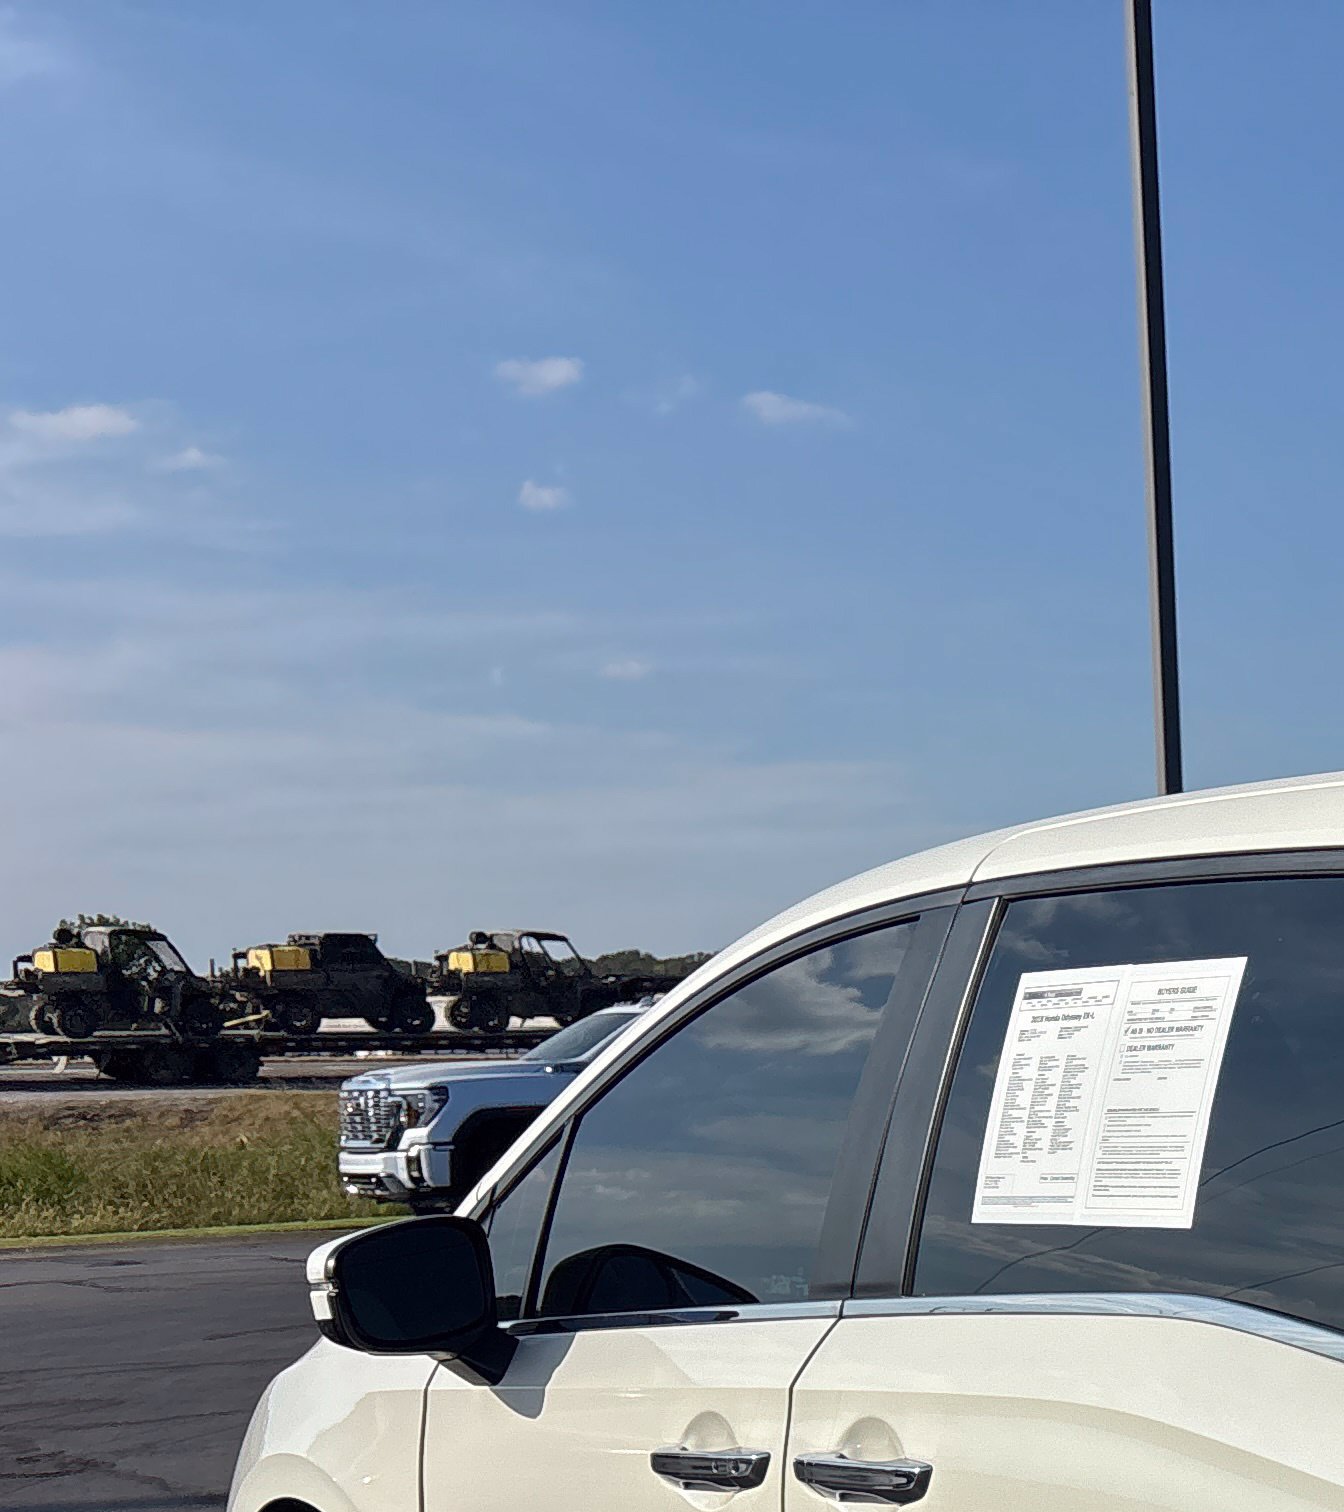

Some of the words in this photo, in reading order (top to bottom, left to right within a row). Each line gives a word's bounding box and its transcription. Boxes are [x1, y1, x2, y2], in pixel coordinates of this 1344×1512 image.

[1061, 1013, 1082, 1022] Odyssey
[1175, 1025, 1204, 1033] WARRANTY
[1126, 1044, 1146, 1052] DEALER
[1146, 1043, 1175, 1051] WARRANTY
